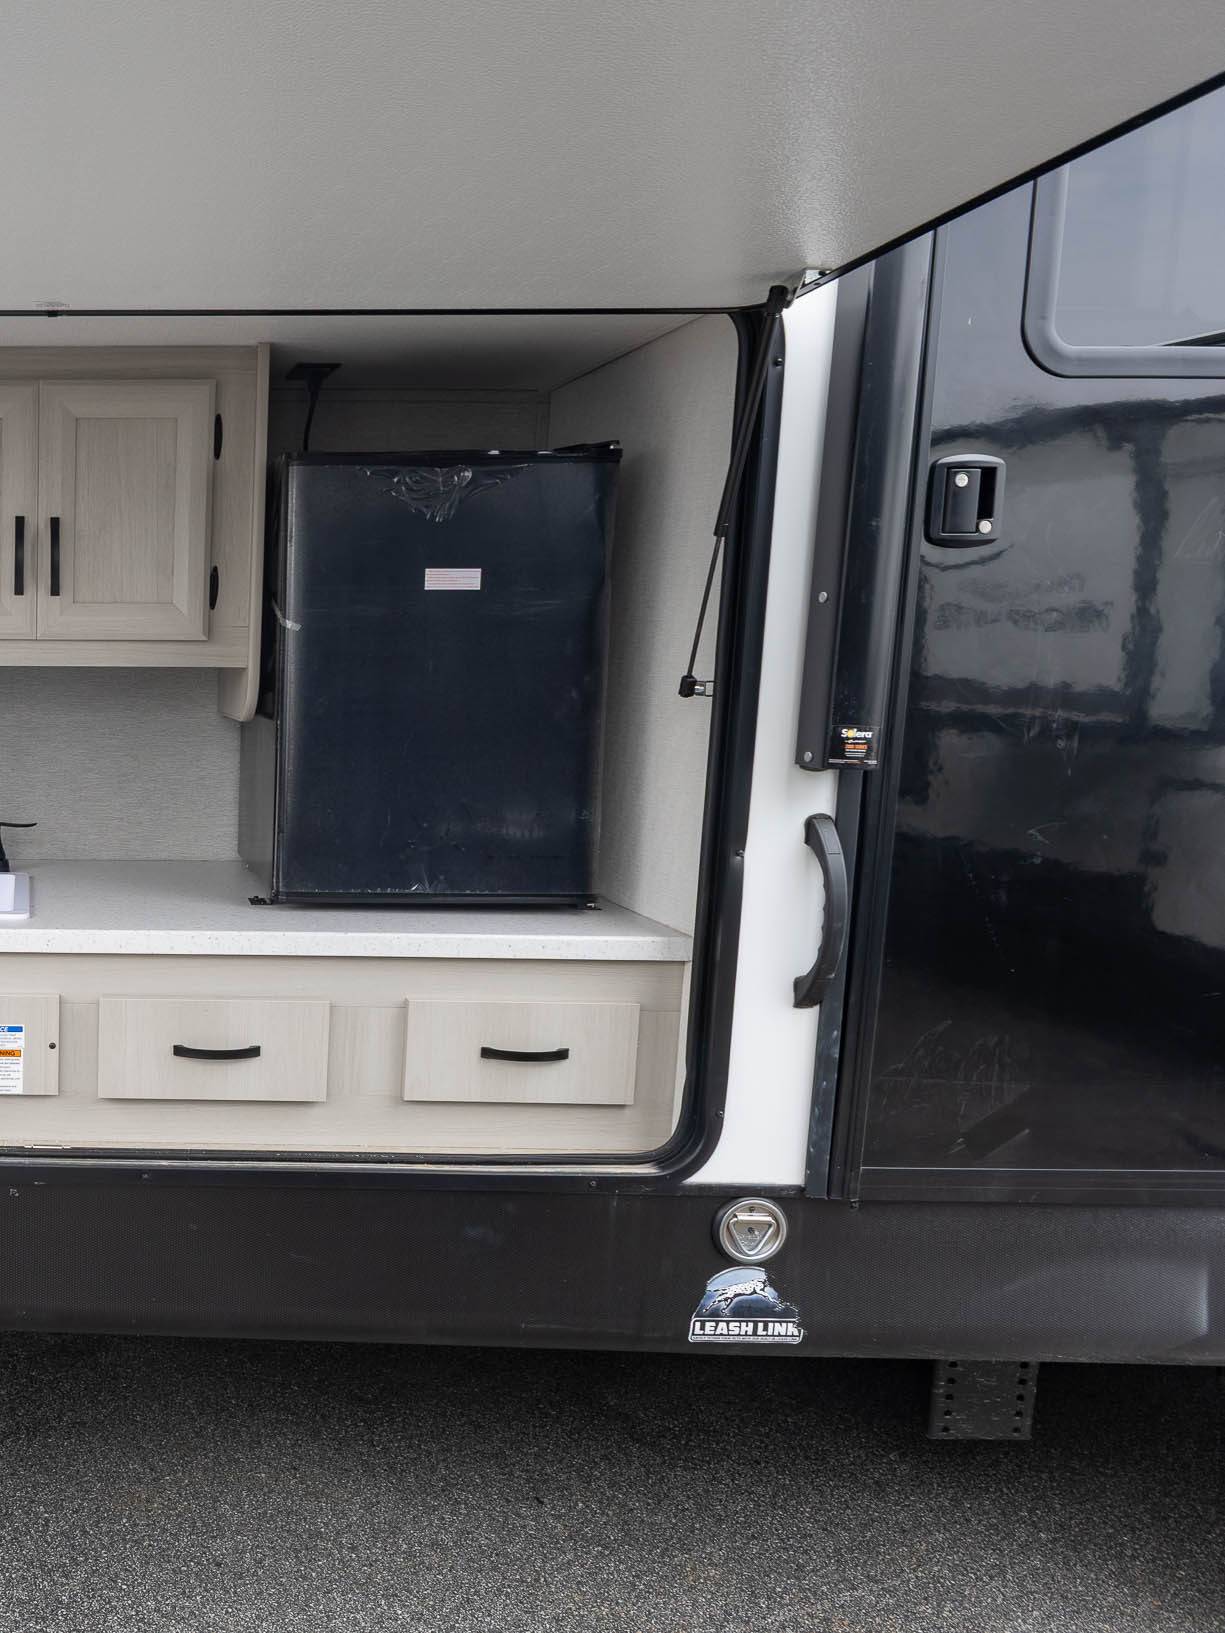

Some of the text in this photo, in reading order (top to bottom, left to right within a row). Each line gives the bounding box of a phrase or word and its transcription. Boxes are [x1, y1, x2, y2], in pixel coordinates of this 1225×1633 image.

[840, 728, 873, 738] Solera
[694, 1321, 800, 1336] LEASH LINK
